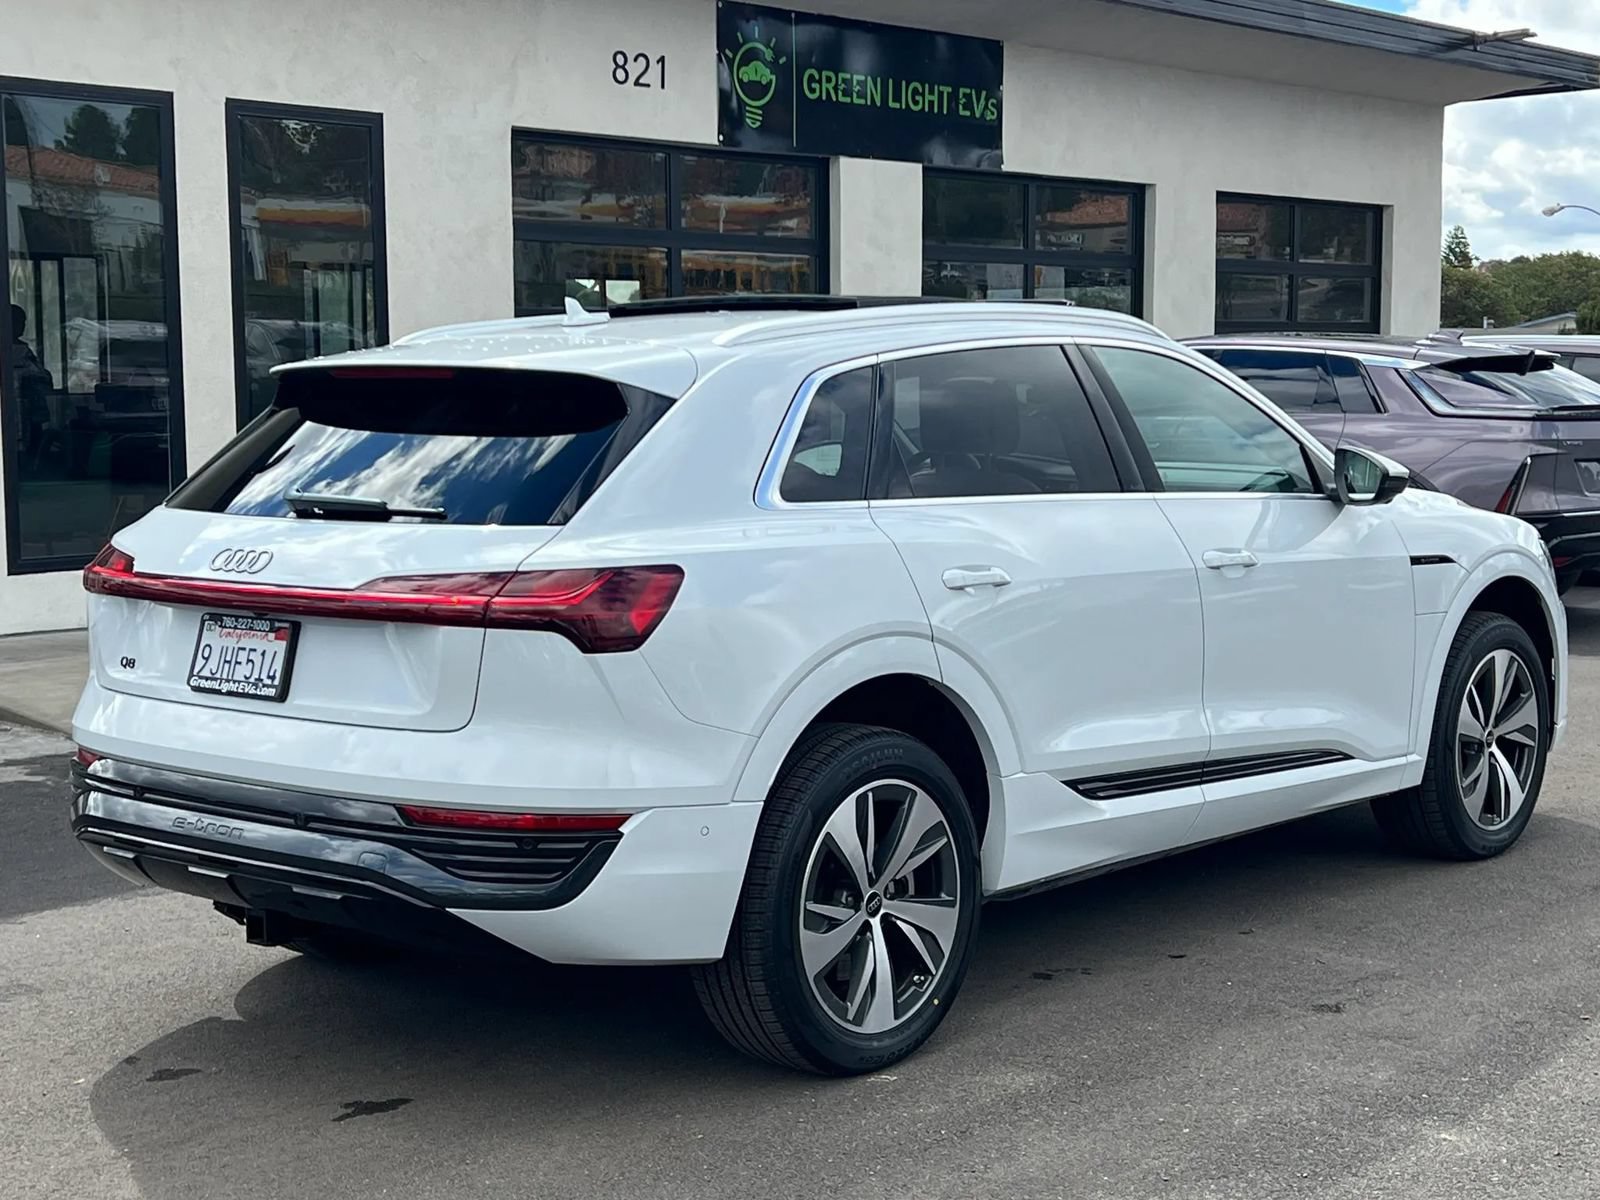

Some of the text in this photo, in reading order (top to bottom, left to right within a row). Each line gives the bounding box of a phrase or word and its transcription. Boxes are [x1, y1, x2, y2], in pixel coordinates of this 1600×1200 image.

[612, 50, 666, 90] 821
[803, 68, 998, 121] GREEN LIGHT EVs
[222, 616, 270, 631] 760-227-1000
[219, 628, 273, 644] California
[120, 655, 136, 669] Q8
[196, 644, 277, 684] 9JHF514
[190, 676, 276, 697] GreenLightEVs.com
[171, 815, 245, 840] e-tron
